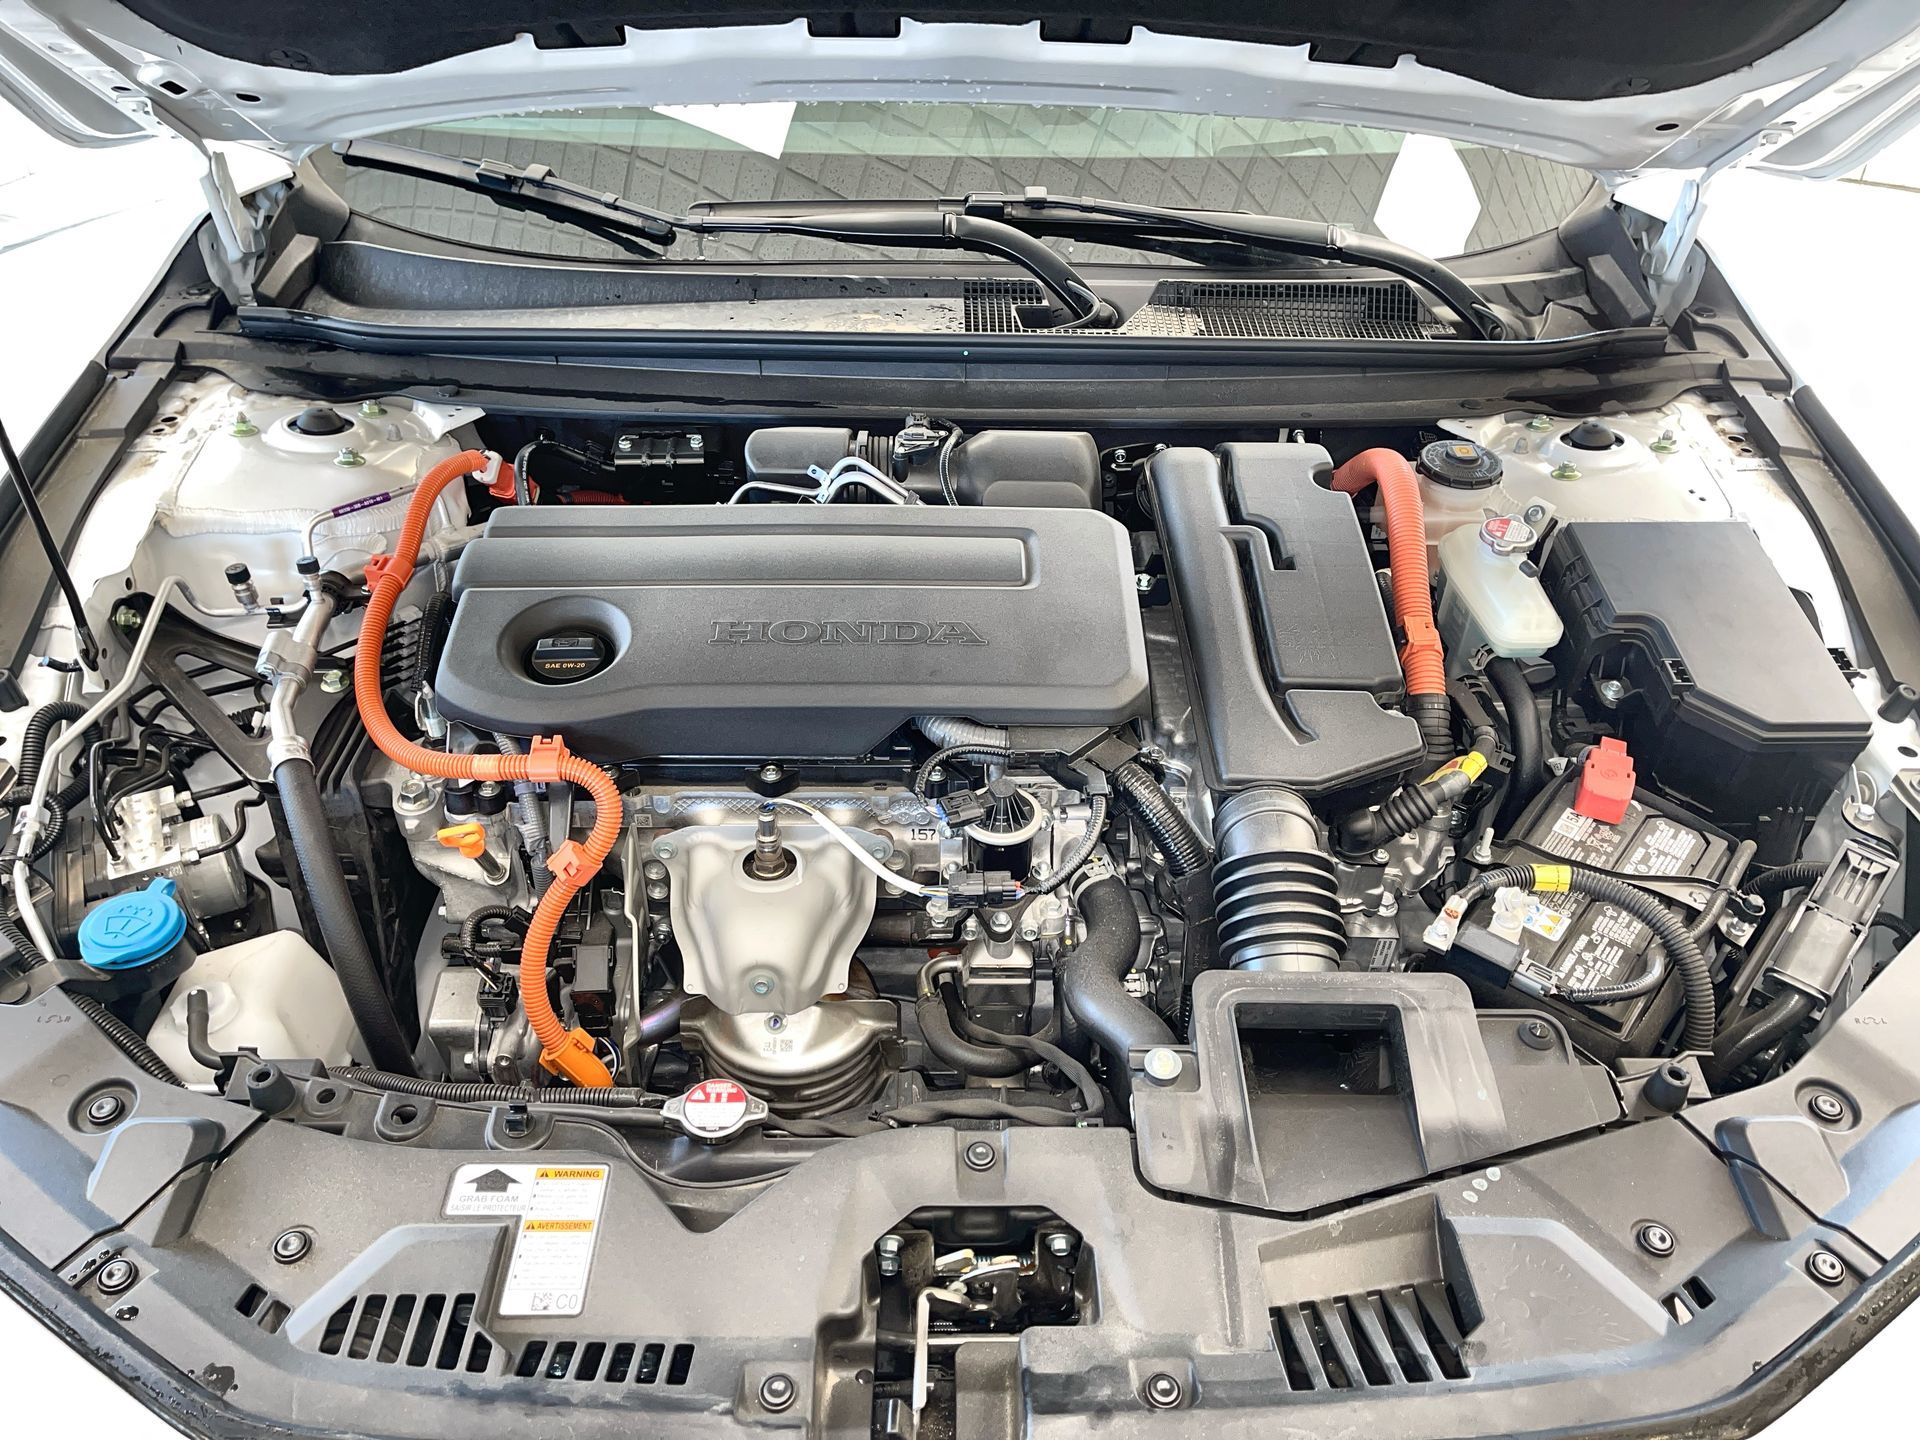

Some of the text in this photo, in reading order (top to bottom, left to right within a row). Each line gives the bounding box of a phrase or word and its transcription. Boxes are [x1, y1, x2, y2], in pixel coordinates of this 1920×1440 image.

[708, 620, 988, 645] HONDA
[911, 828, 936, 841] 157
[554, 1170, 600, 1178] WARNING
[459, 1195, 519, 1203] GRAB FOAM
[472, 1204, 482, 1212] LE
[482, 1204, 527, 1212] PROTECTEUR
[536, 1221, 592, 1230] AVERTISSEMENT
